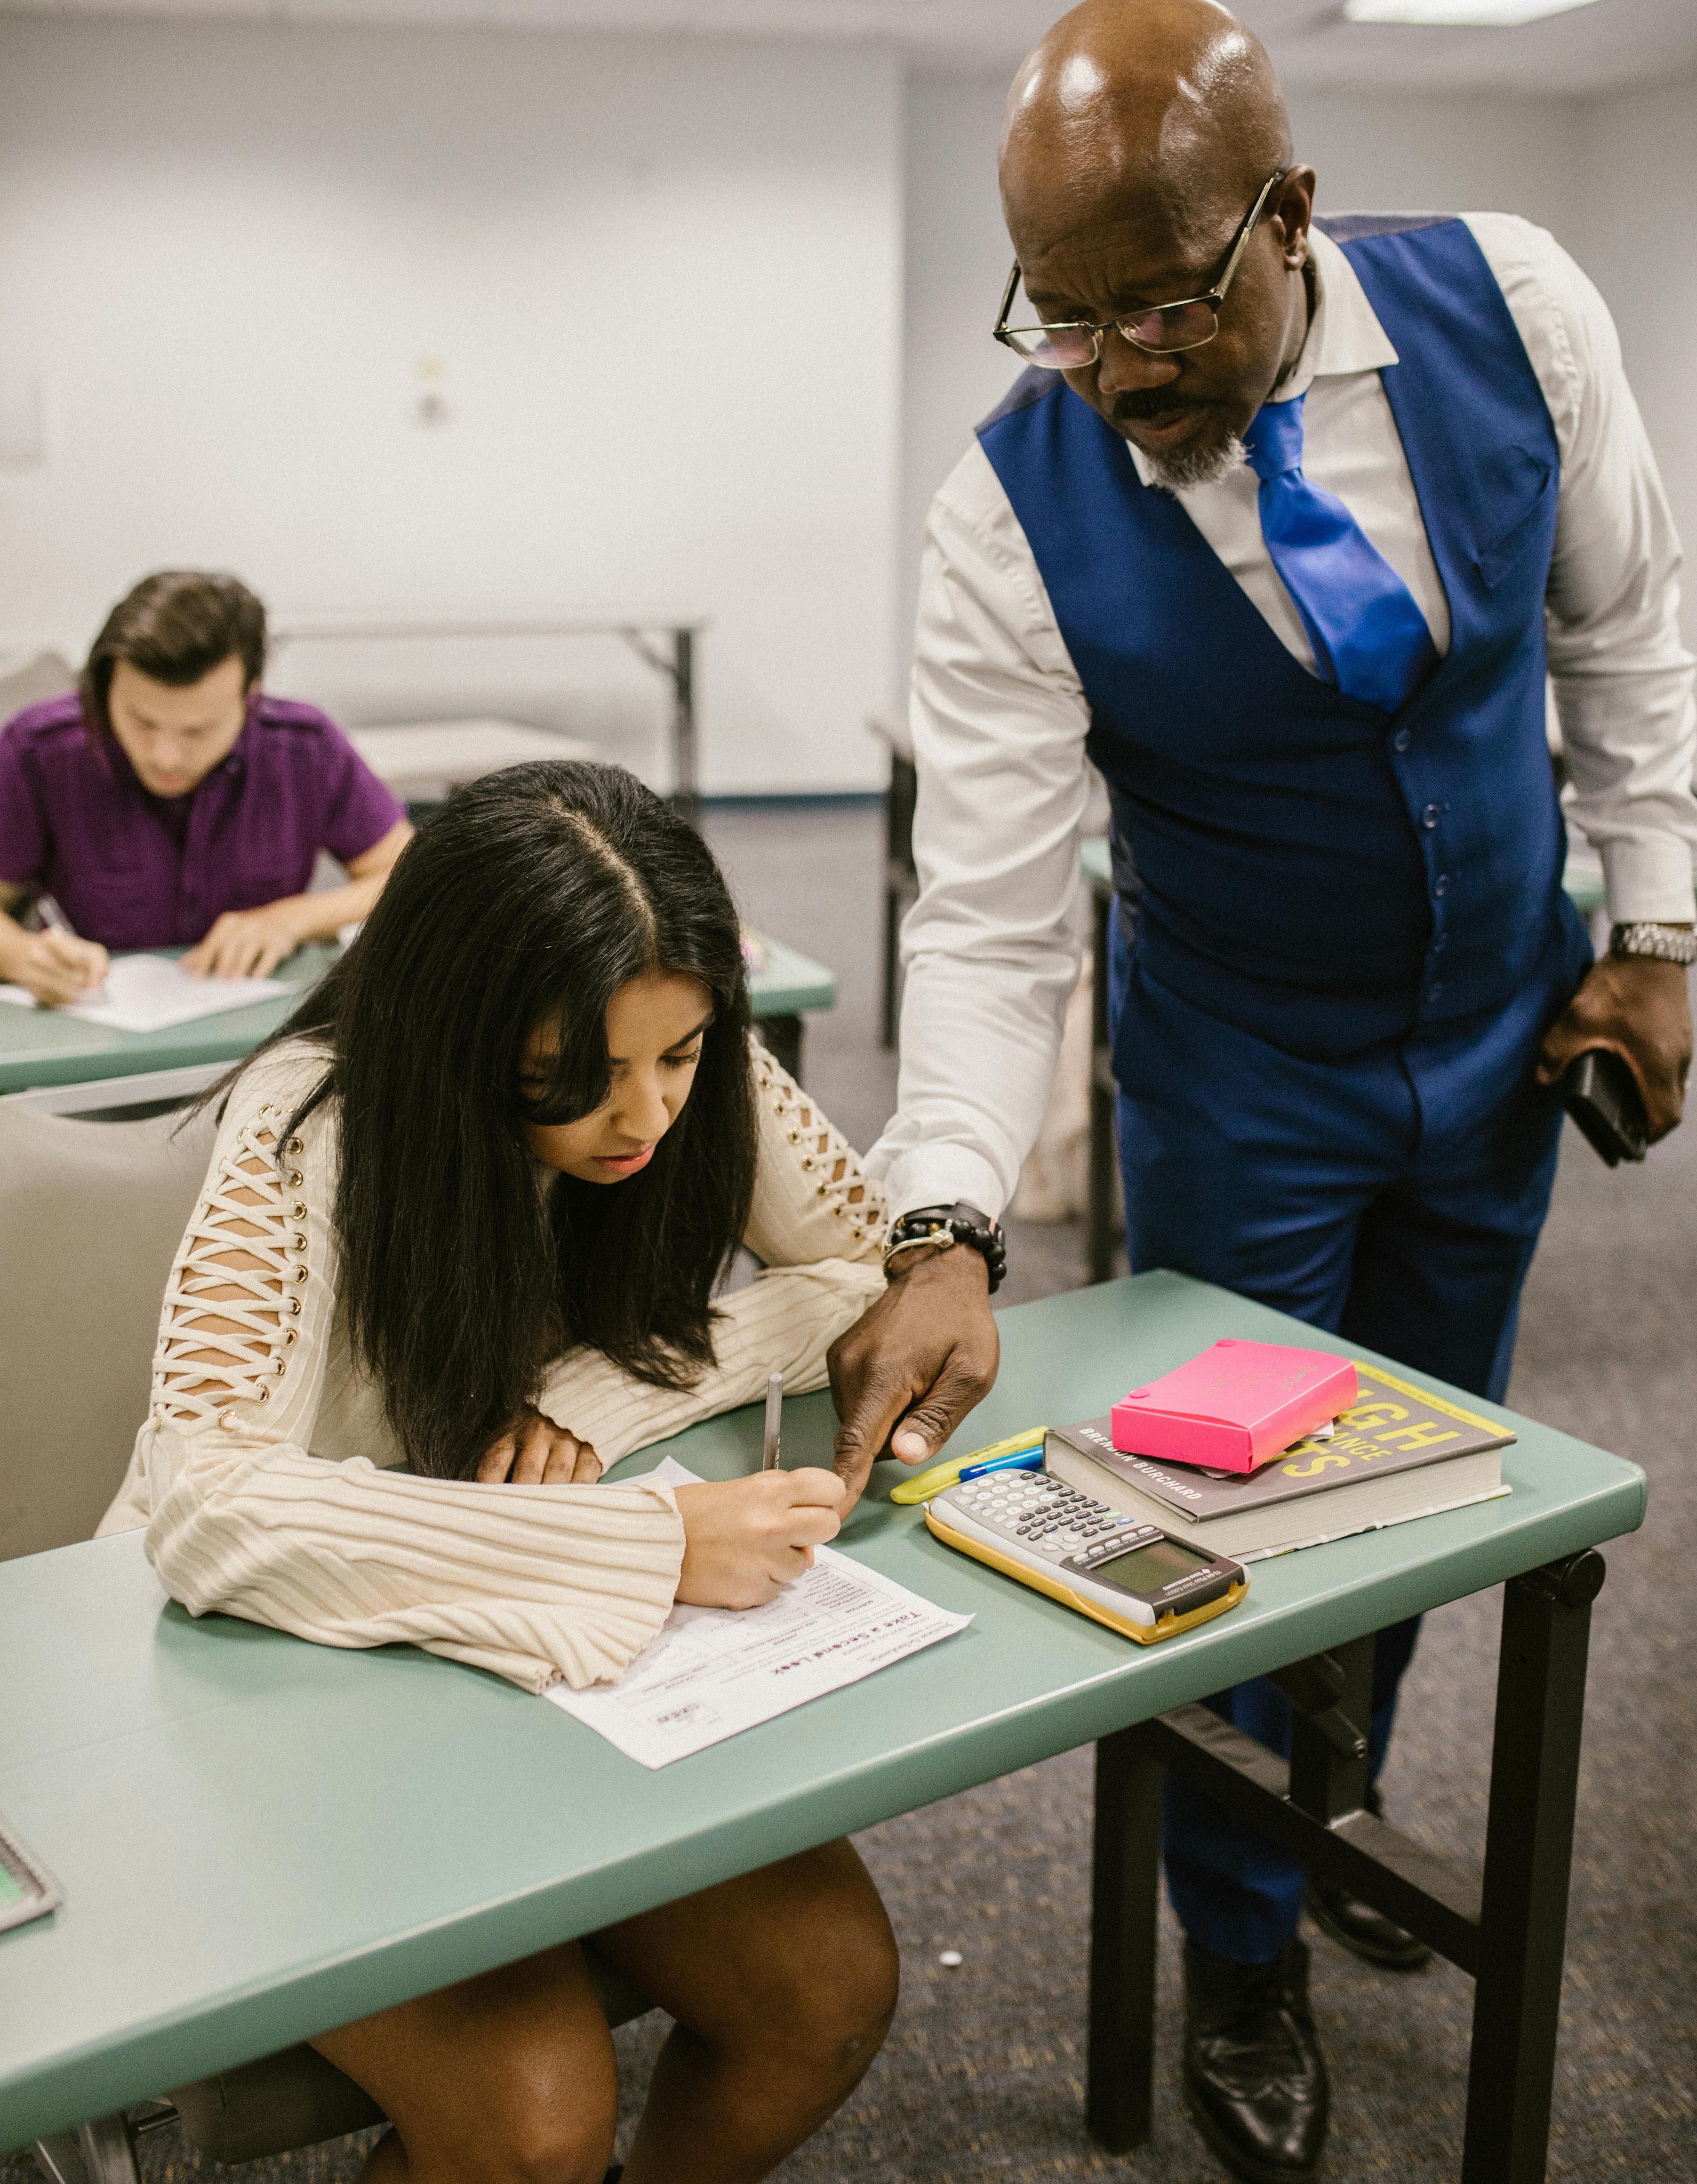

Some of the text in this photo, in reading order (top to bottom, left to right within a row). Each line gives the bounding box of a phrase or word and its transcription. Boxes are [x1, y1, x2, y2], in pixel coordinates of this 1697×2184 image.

[1339, 1388, 1462, 1452] GH
[1265, 1441, 1351, 1477] TS
[1328, 1426, 1393, 1461] ANCE
[1133, 1462, 1203, 1500] BURCHARD
[883, 1612, 922, 1627] Take
[813, 1633, 870, 1658] Second
[770, 1656, 812, 1675] Look
